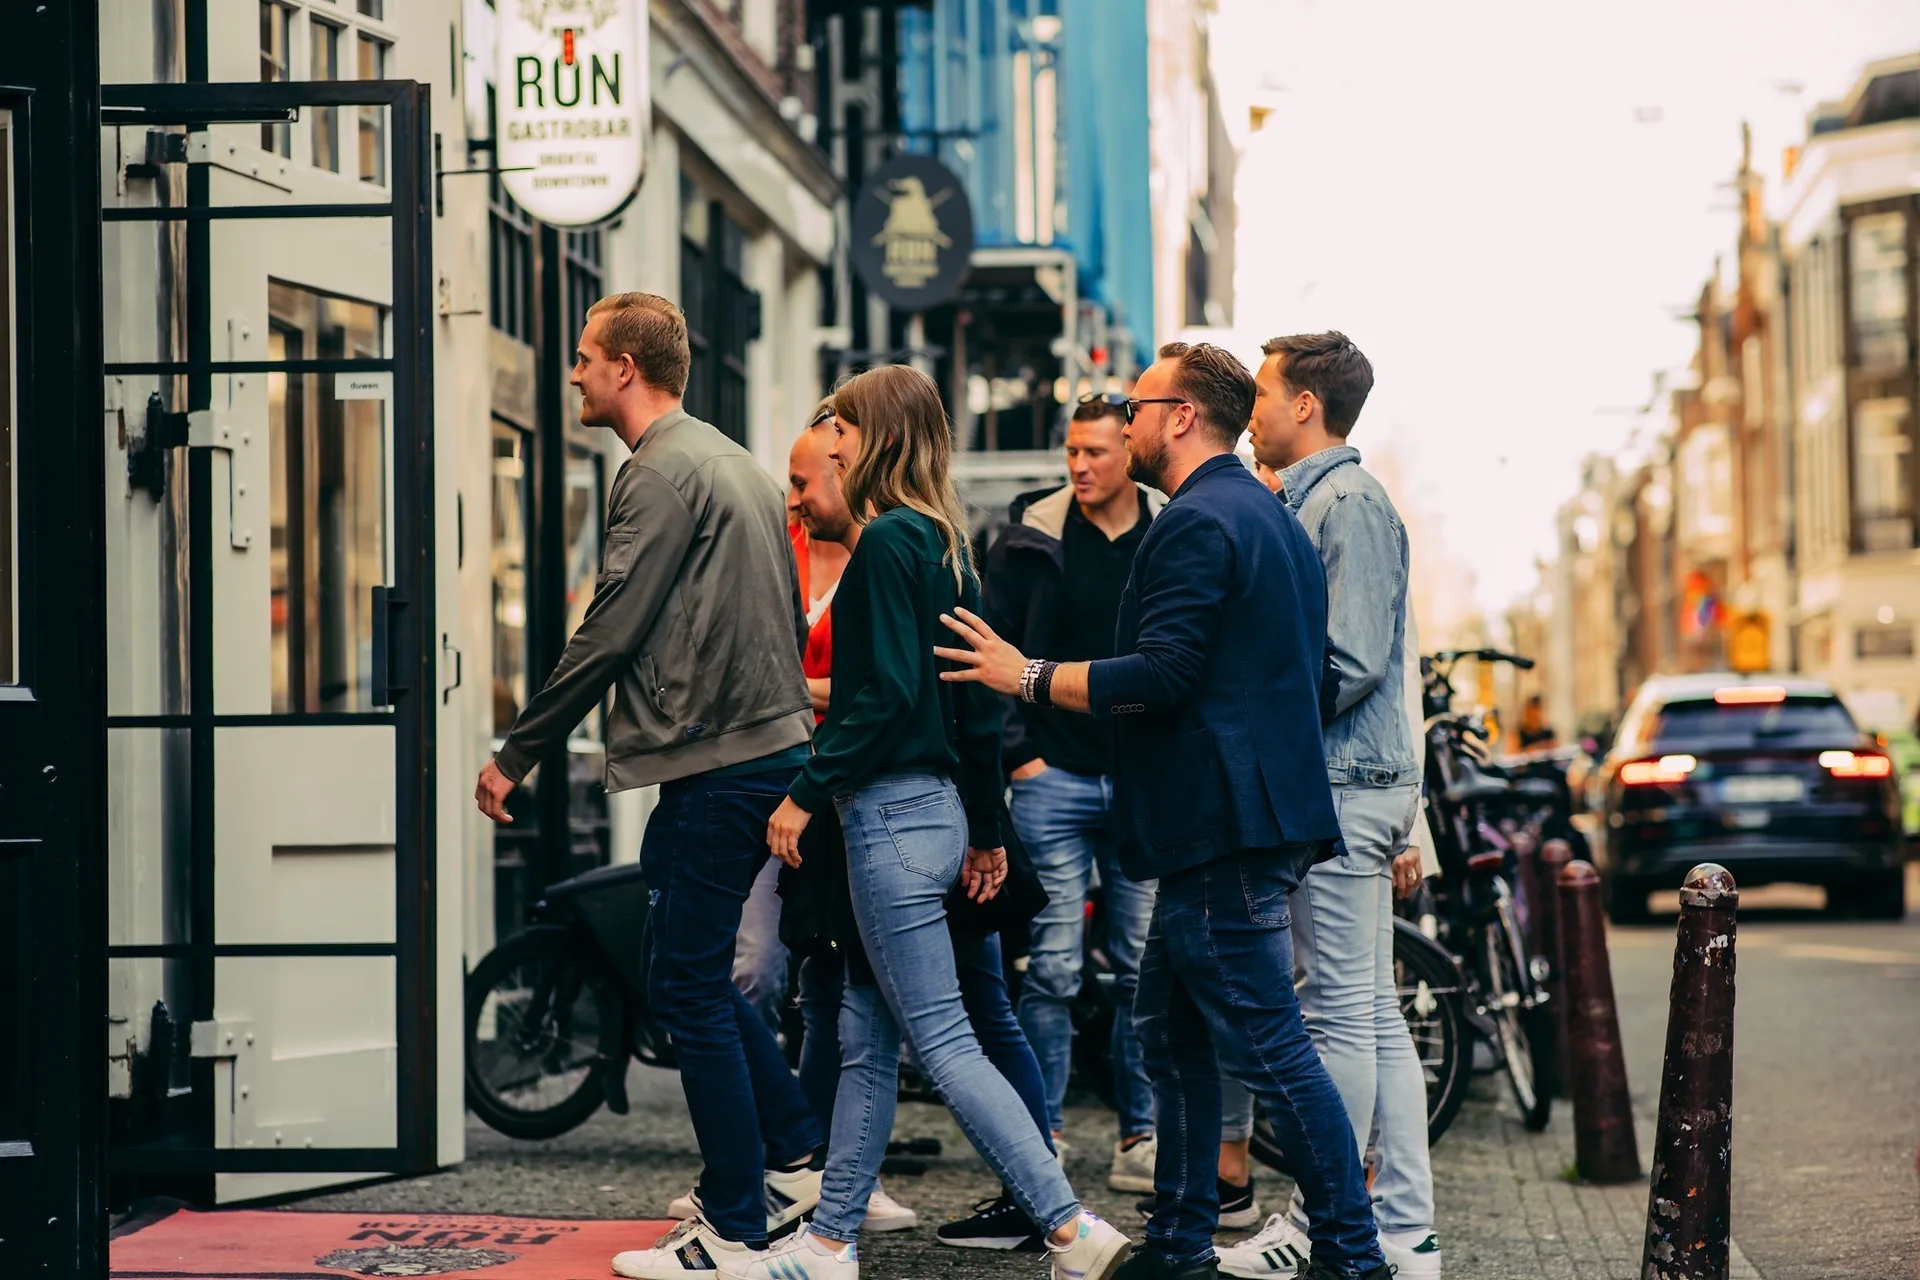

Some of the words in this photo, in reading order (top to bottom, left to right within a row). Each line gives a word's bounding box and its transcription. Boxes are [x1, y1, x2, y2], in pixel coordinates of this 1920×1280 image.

[516, 53, 620, 108] RON
[507, 119, 631, 141] GASTROBAR
[347, 1229, 558, 1245] RON
